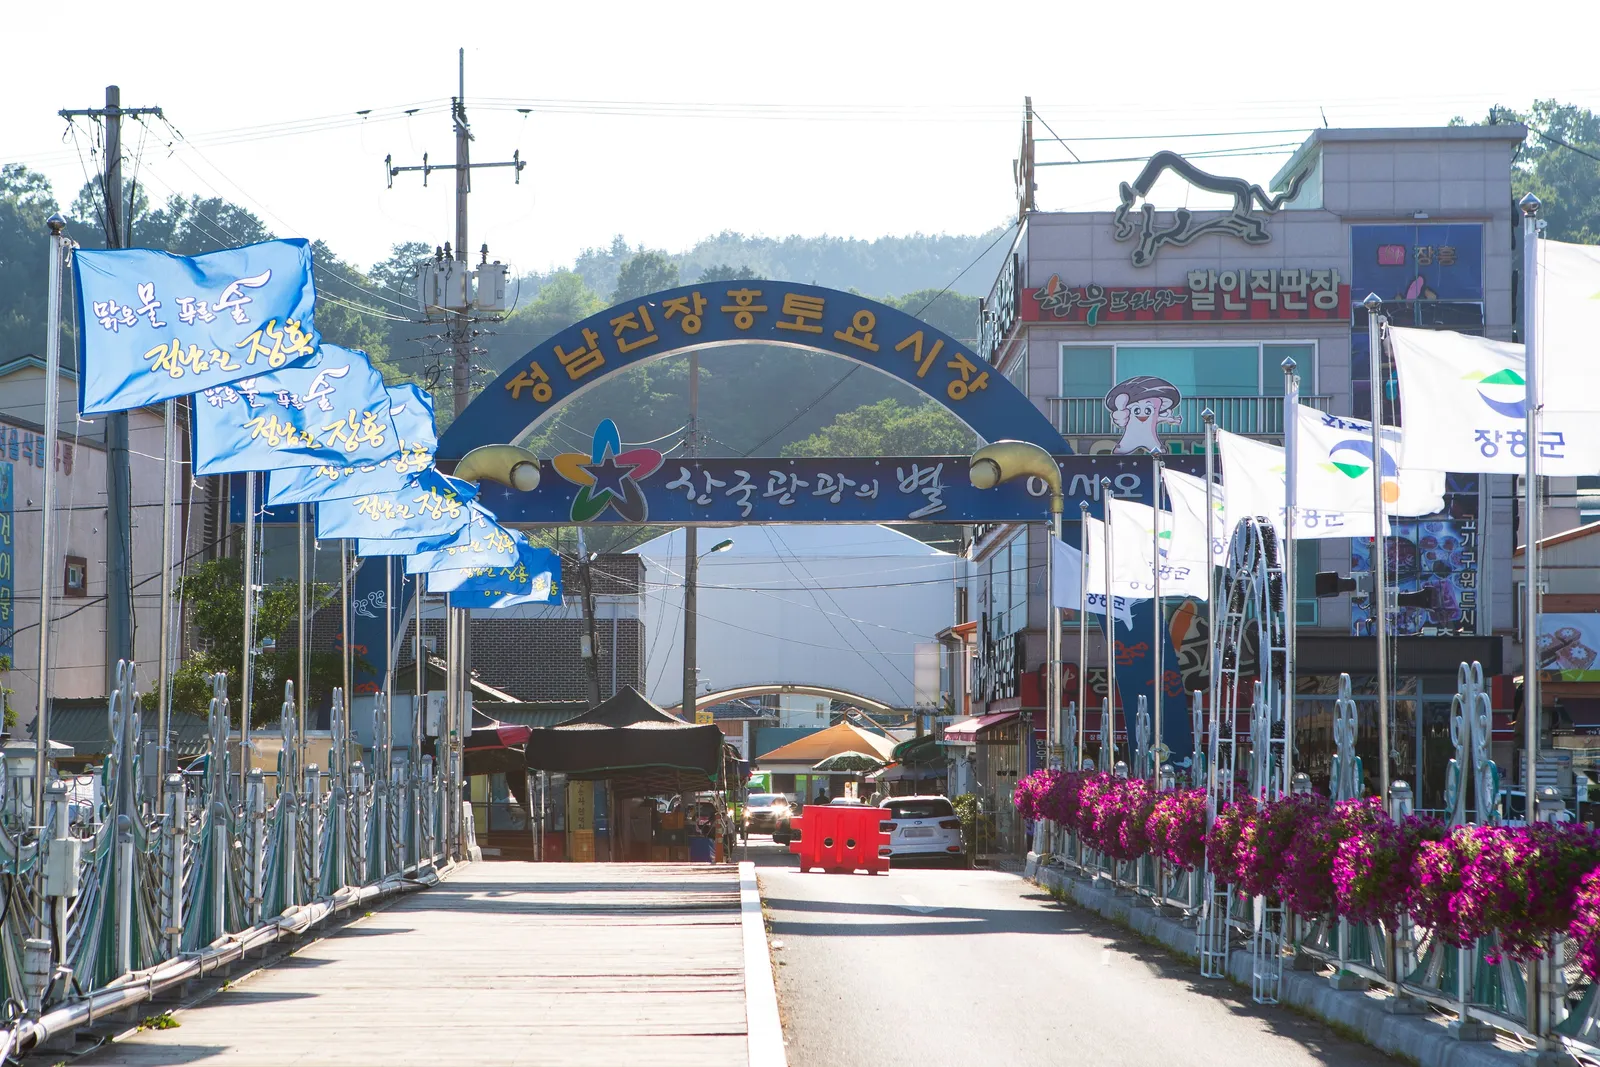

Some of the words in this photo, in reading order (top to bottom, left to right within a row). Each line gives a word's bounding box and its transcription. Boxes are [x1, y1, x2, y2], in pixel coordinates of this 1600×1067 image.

[175, 269, 272, 325] 푸른숲
[1187, 268, 1341, 311] 할인직판장
[144, 338, 242, 379] 정남진
[322, 408, 387, 452] 장흥
[1474, 429, 1566, 458] 장흥군
[352, 495, 415, 521] 정남진
[412, 486, 463, 520] 장흥
[896, 462, 947, 519] 별
